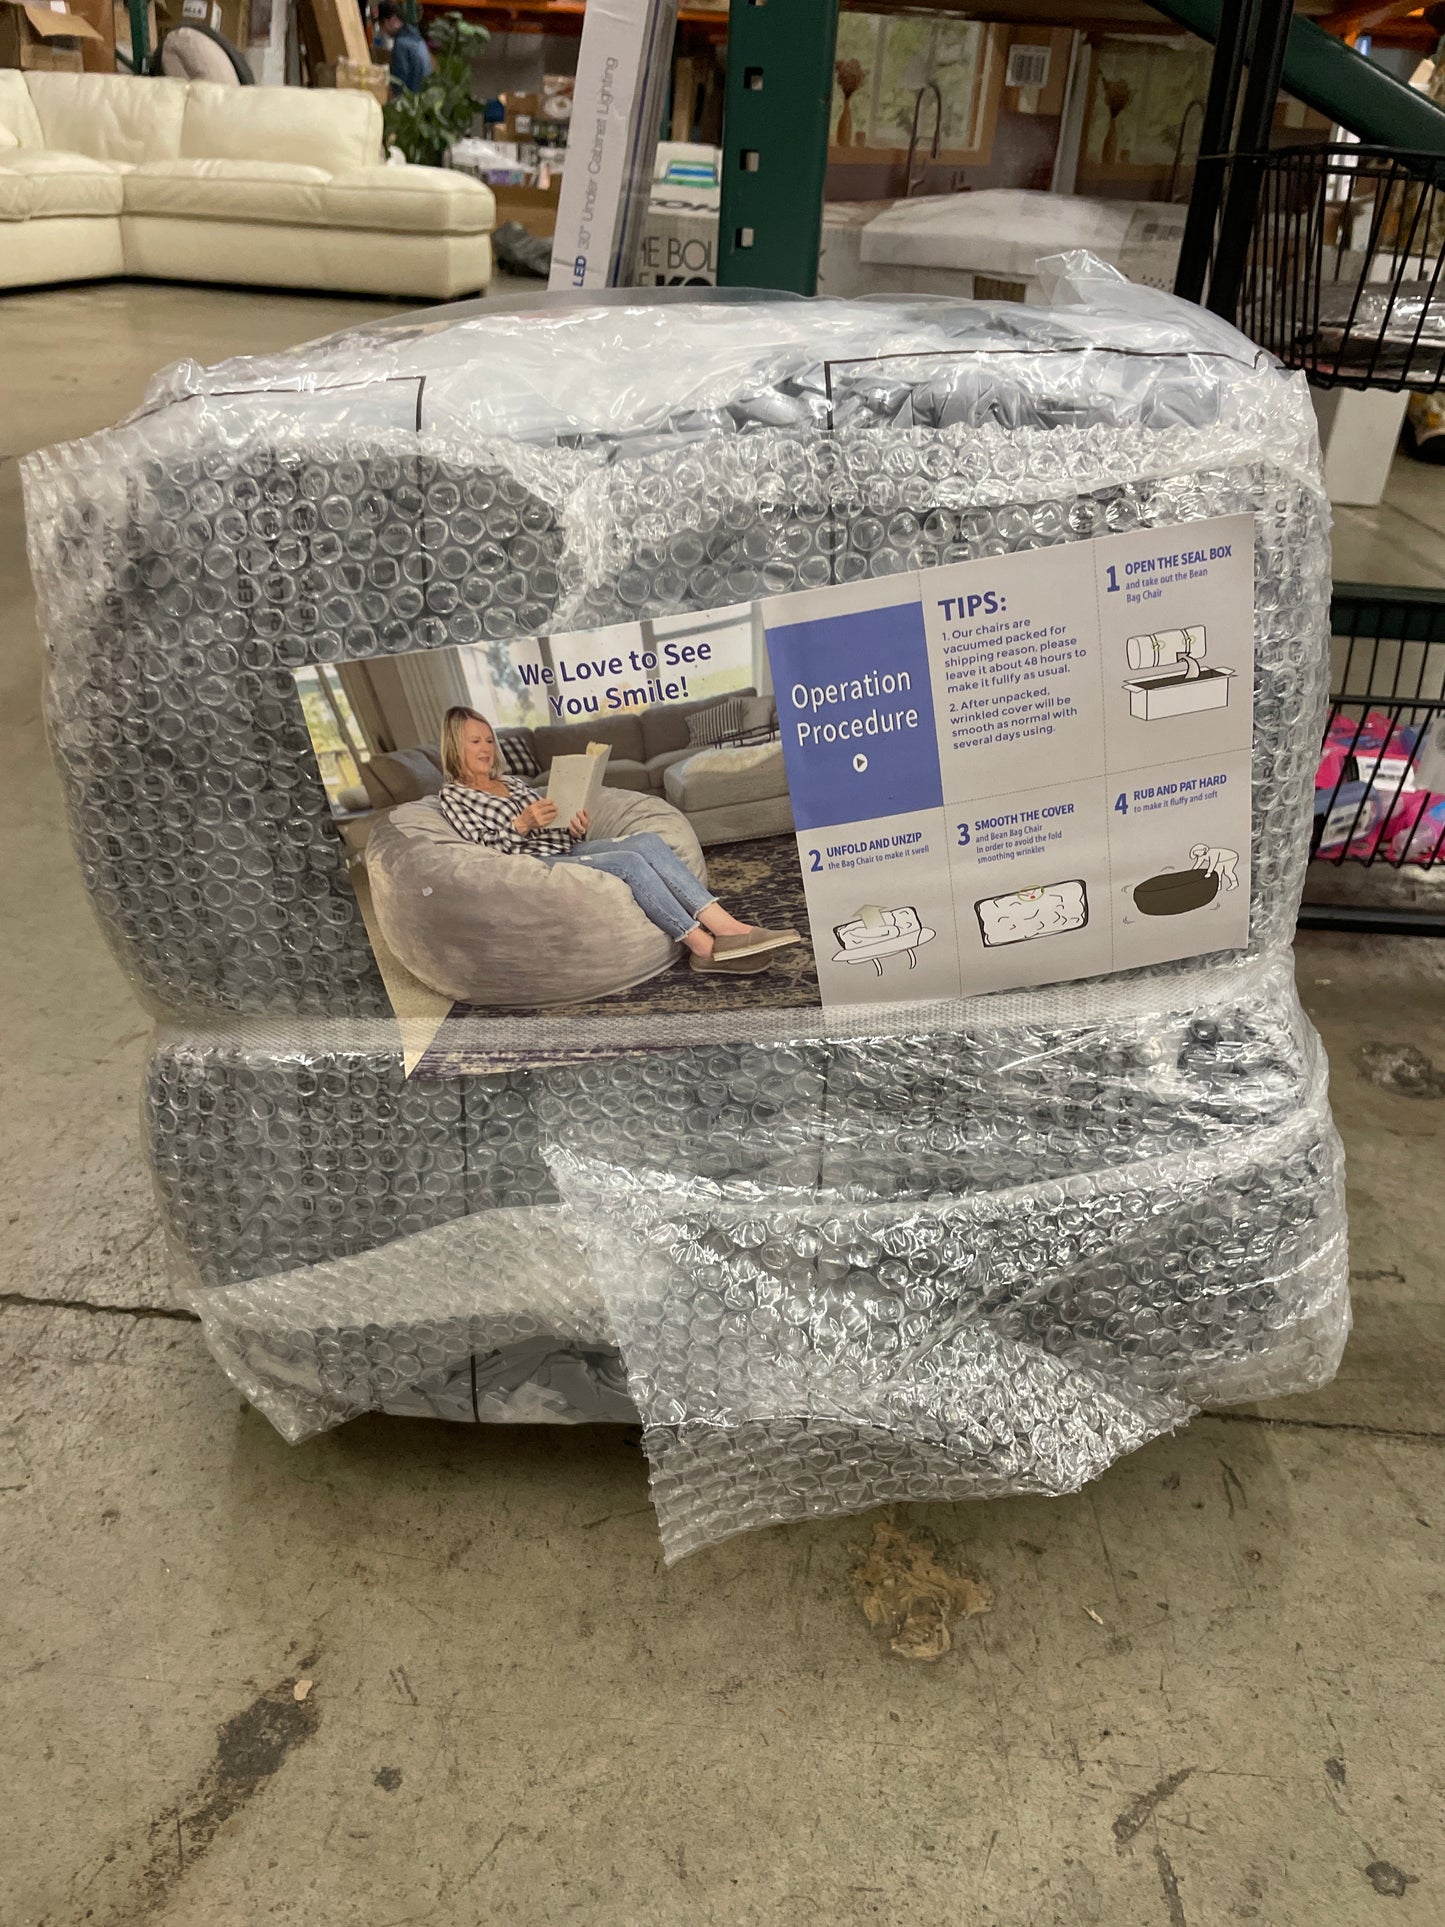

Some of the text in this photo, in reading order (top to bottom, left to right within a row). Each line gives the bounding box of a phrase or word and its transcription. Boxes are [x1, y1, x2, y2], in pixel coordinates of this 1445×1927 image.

[596, 57, 618, 115] Lighting
[588, 119, 606, 174] Cabinet
[583, 178, 597, 222] Under
[572, 255, 587, 287] LED
[1125, 545, 1232, 575] OPEN THE SEAL BOX
[1106, 566, 1120, 592] 1
[1126, 568, 1208, 590] and take out the Bean
[938, 591, 1006, 621] TIPS:
[1126, 589, 1162, 604] Bag Chair
[942, 619, 1031, 641] 1. Our chairs are
[943, 625, 1066, 654] vacuumed packed for
[518, 643, 712, 686] We Love to See
[945, 651, 994, 667] shipping
[1040, 637, 1077, 653] please
[946, 649, 1086, 680] leave it about 48 hours to
[792, 670, 911, 713] Operation
[947, 680, 978, 694] make
[981, 678, 989, 688] it
[1024, 672, 1036, 680] as
[1038, 664, 1071, 677] usual.
[549, 676, 688, 717] You Smile!
[949, 704, 958, 712] 2.
[961, 699, 989, 710] After
[950, 697, 1071, 725] wrinkled cover will be
[952, 722, 994, 737] smooth
[1011, 711, 1050, 726] normal
[1052, 707, 1077, 718] with
[797, 708, 918, 747] Procedure
[953, 725, 1056, 750] several days using.
[1134, 774, 1227, 800] RUB AND PAT HARD
[1114, 793, 1128, 815] 4
[1143, 801, 1162, 812] make
[1170, 796, 1188, 806] fluffy
[1189, 793, 1203, 802] and
[1204, 790, 1218, 800] soft
[975, 803, 1074, 830] SMOOTH THE COVER
[827, 832, 922, 857] UNFOLD AND UNZIP
[957, 823, 970, 846] 3
[976, 824, 1042, 843] and Bean Bag Chair
[985, 842, 1004, 852] order
[1015, 836, 1033, 846] avoid
[1035, 834, 1046, 843] the
[1048, 831, 1062, 840] fold
[809, 849, 823, 872] 2
[829, 861, 840, 869] the
[842, 860, 854, 868] Bag
[856, 856, 875, 865] Chair
[885, 851, 903, 860] make
[912, 845, 929, 855] swell
[978, 846, 1045, 864] smoothing wrinkles
